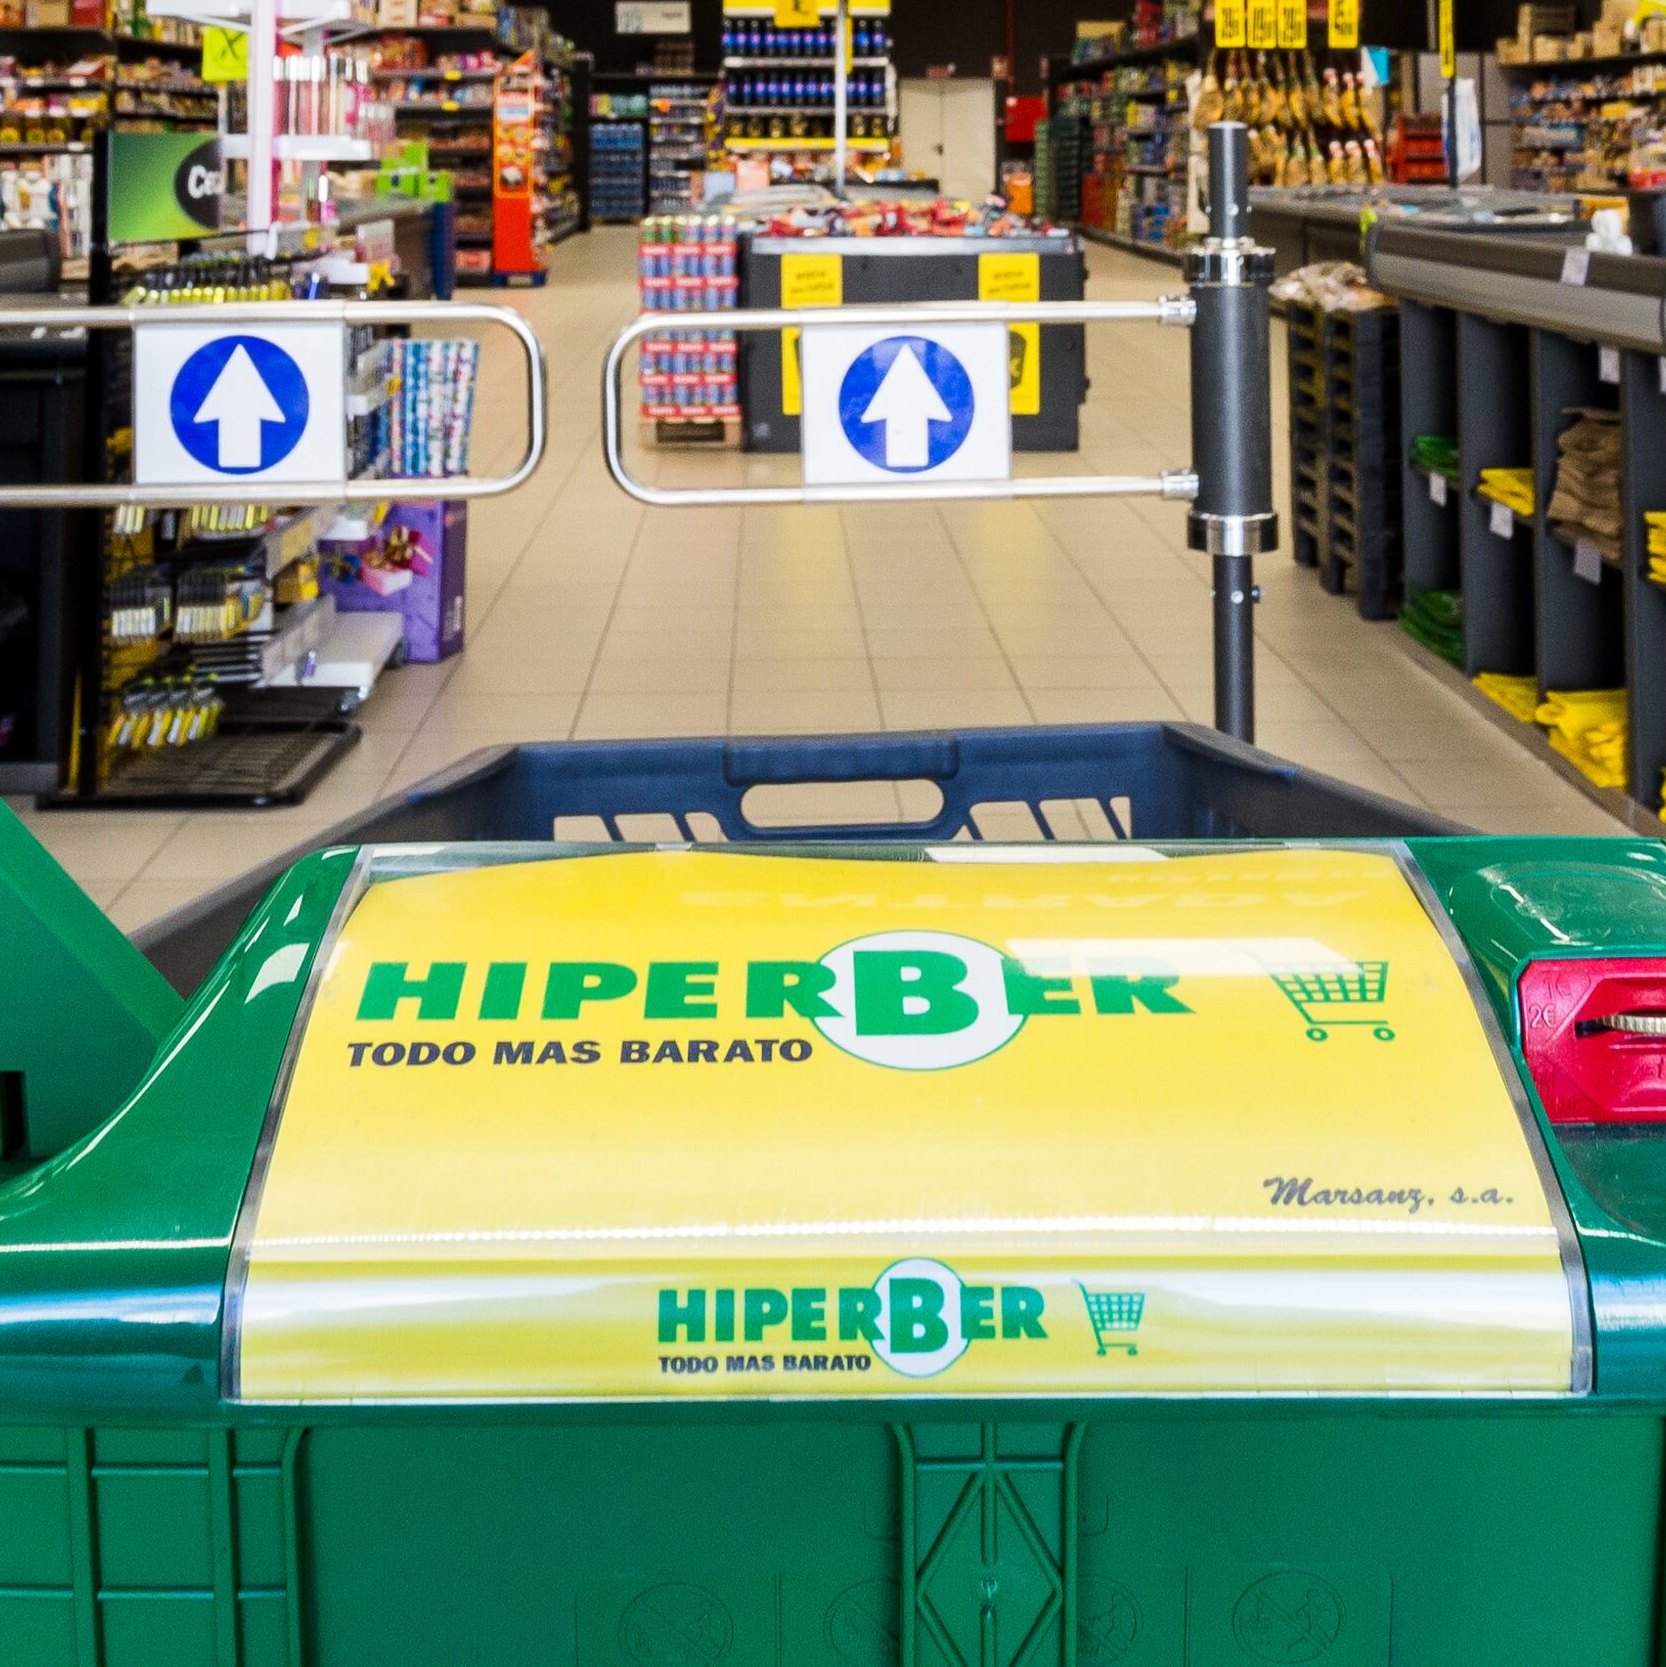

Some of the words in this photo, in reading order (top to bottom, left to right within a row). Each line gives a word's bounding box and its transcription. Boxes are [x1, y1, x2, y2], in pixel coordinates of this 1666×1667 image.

[355, 949, 1197, 1038] HIPERBER
[347, 1041, 477, 1068] TODO
[493, 1040, 602, 1066] MAS
[619, 1038, 814, 1065] BARATO
[1448, 1186, 1515, 1205] s.a.
[657, 1277, 1049, 1354] HIPERBER
[659, 1355, 719, 1374] TODO
[725, 1354, 776, 1373] MAS
[782, 1353, 872, 1373] BARATO
